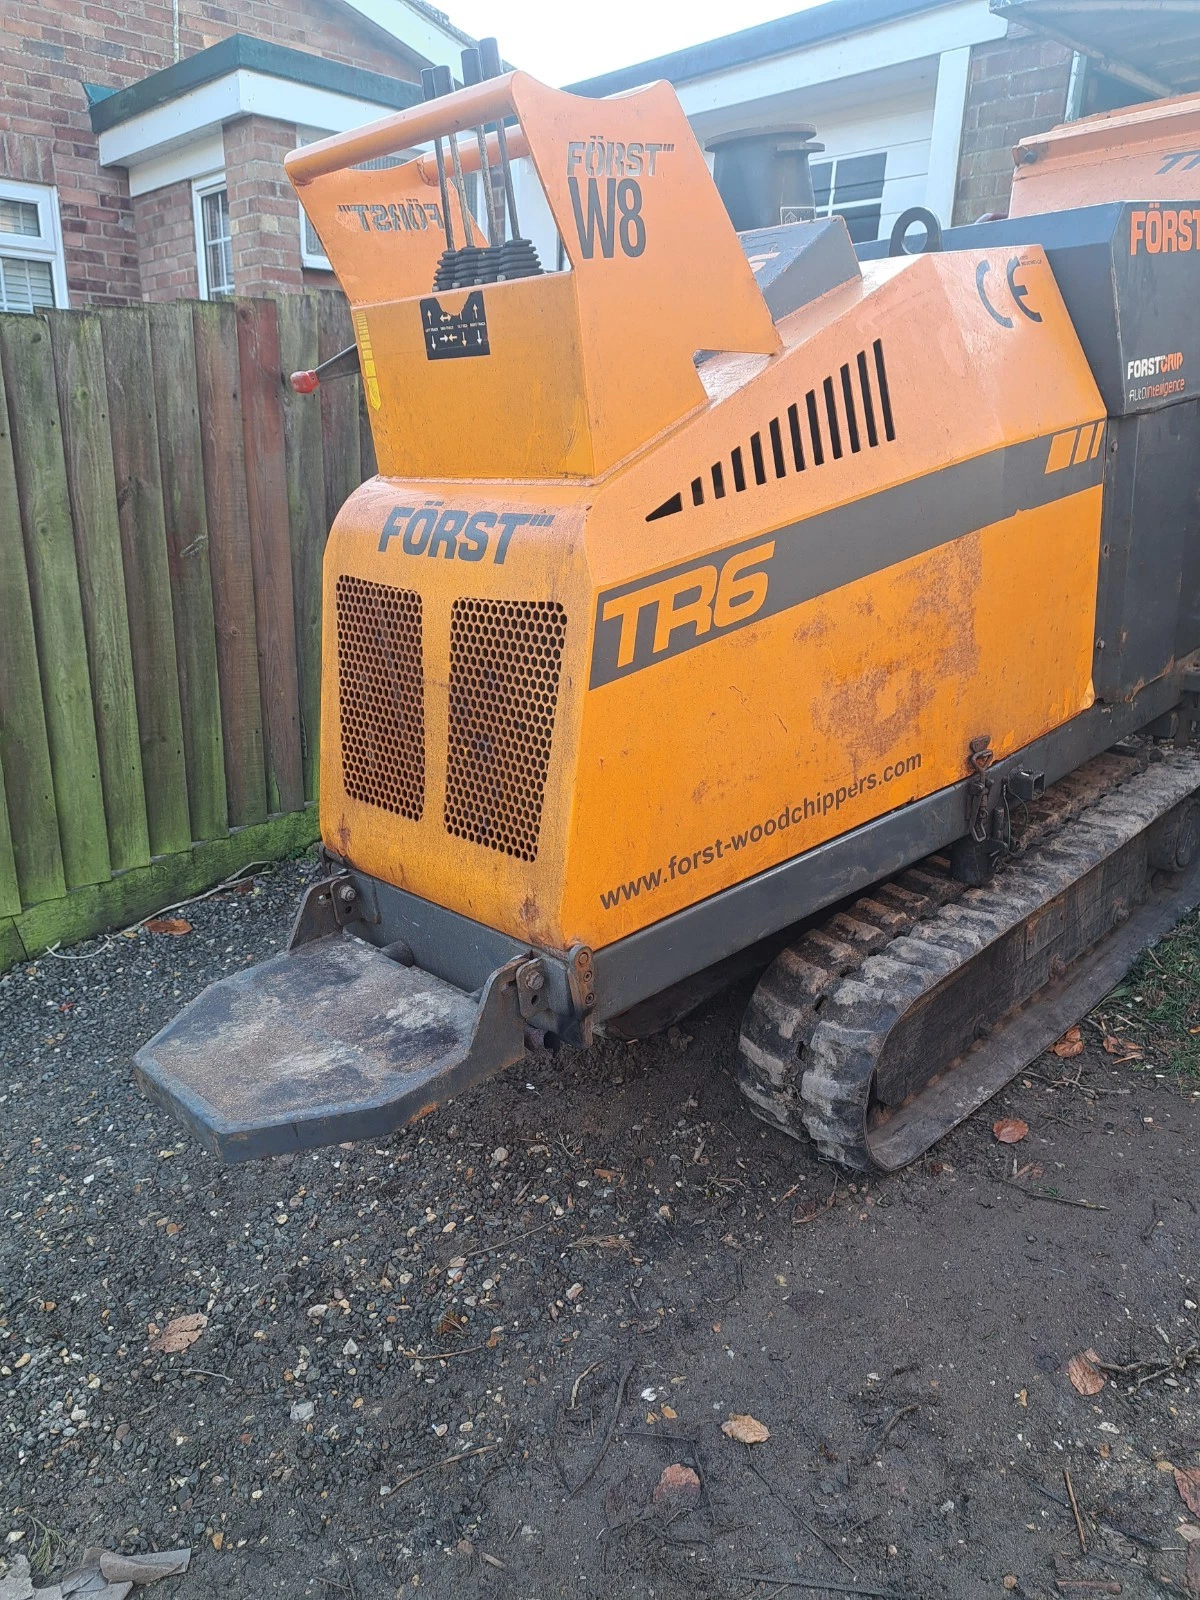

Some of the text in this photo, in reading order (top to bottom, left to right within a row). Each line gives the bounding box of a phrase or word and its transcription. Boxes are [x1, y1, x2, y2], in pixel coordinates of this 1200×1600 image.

[567, 176, 646, 260] W8
[377, 500, 534, 565] FÖRST
[602, 540, 776, 668] TR6
[599, 752, 923, 911] www.forst-woodchippers.com
